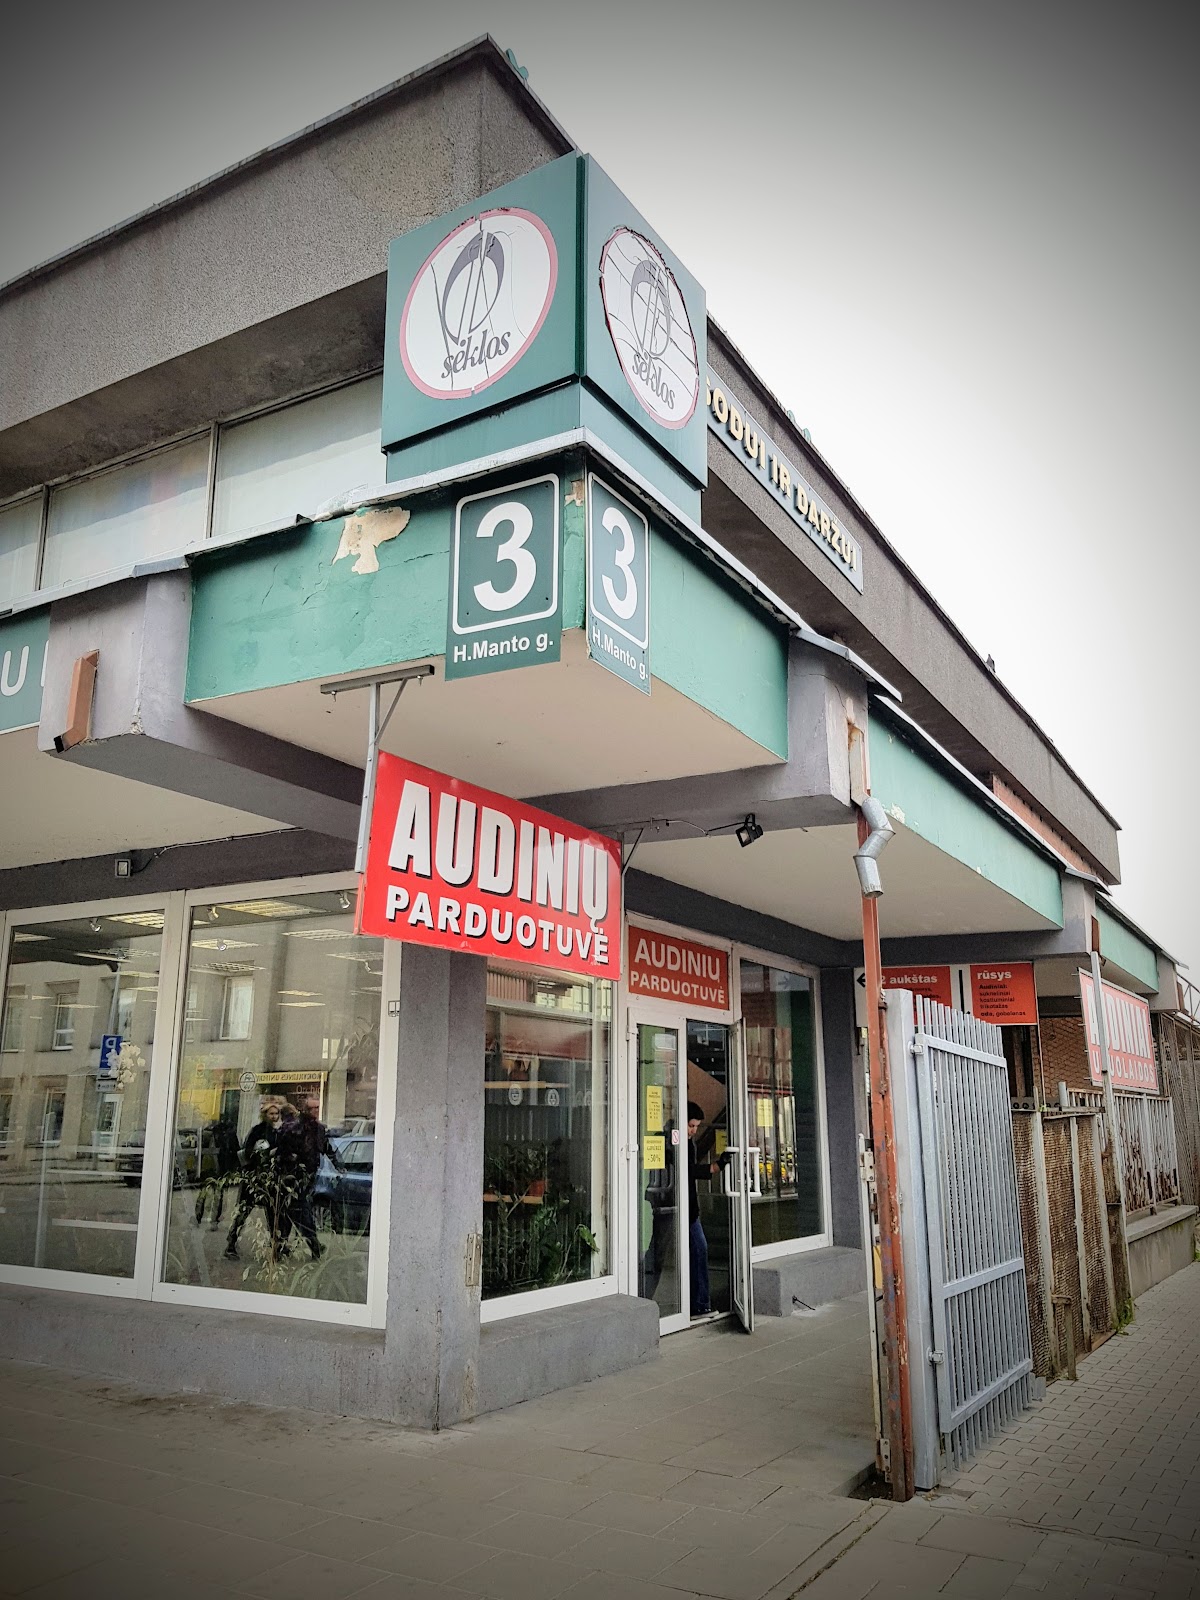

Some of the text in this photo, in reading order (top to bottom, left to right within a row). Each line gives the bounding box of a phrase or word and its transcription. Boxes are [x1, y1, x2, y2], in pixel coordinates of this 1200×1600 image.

[771, 453, 792, 499] IR
[797, 482, 857, 572] DARŽUI
[473, 501, 537, 612] 3
[601, 506, 638, 620] 3
[453, 632, 554, 663] H.Manto g.
[592, 626, 649, 680] H.Manto g.
[387, 778, 609, 934] AUDINIŲ
[385, 884, 609, 965] PARDUOTUVĖ
[634, 938, 720, 983] AUDINIŲ
[889, 974, 938, 984] aukštas
[977, 970, 1012, 981] rūsys
[630, 970, 726, 1004] PARDUOTUVĖ
[1092, 1050, 1155, 1083] UUOLAIDOS
